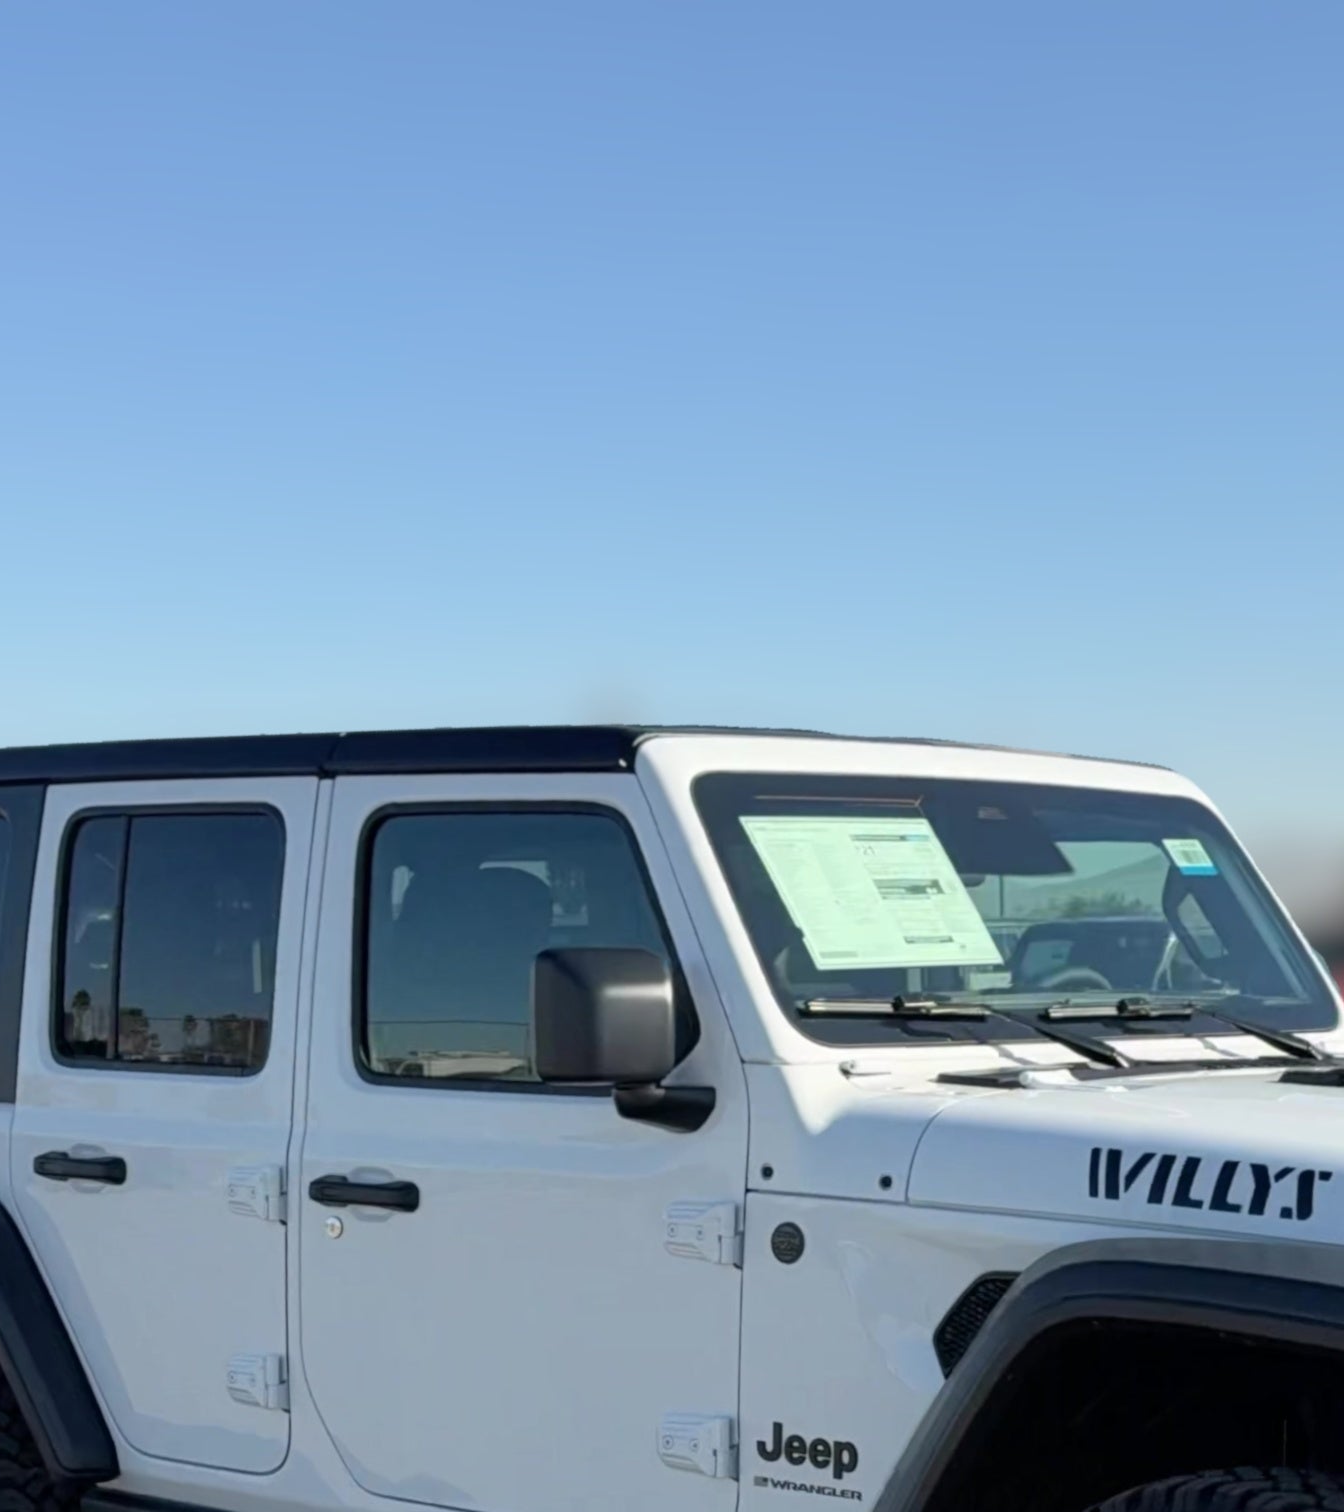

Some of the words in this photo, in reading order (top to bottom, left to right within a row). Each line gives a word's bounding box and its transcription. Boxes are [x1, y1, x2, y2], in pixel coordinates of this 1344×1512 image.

[1089, 1147, 1333, 1221] WILLYS
[756, 1421, 859, 1480] Jeep
[769, 1477, 863, 1501] WRANGLER
